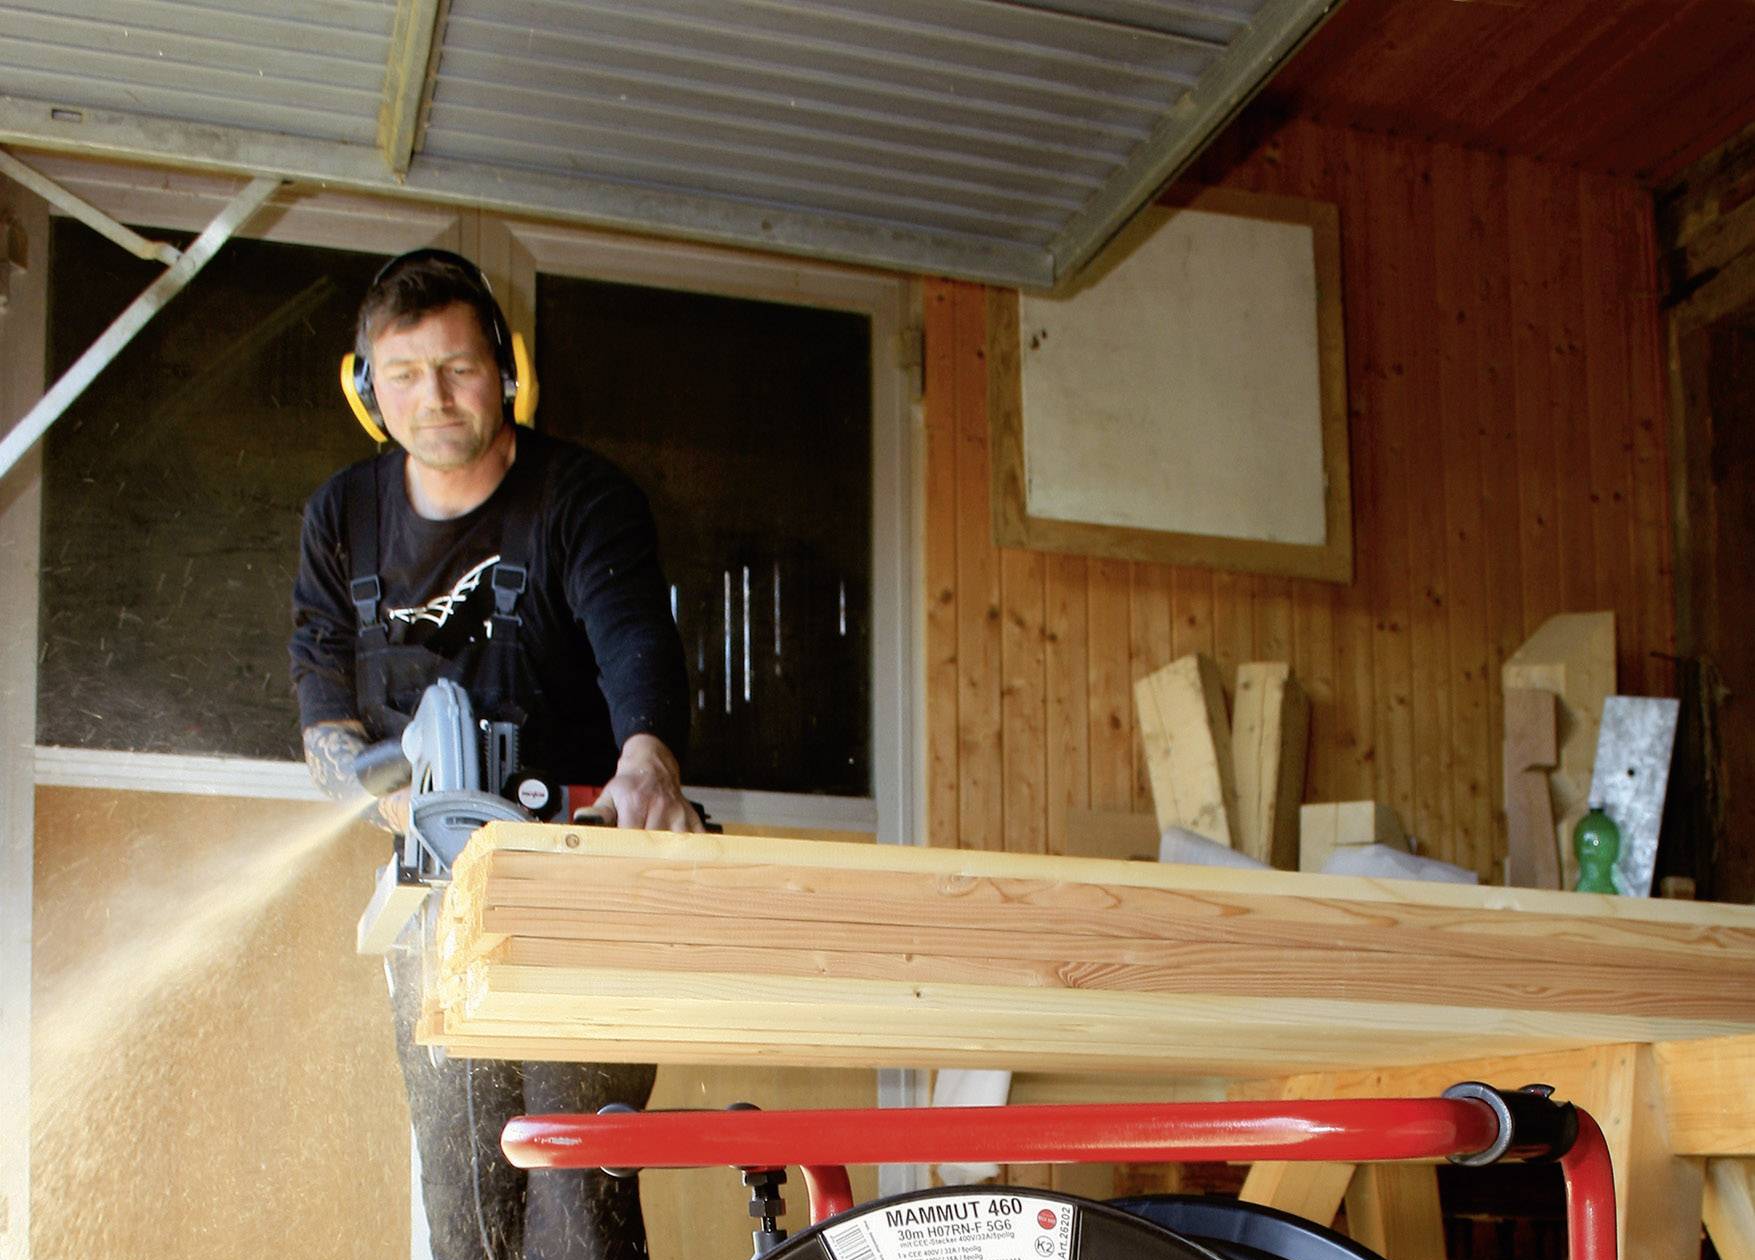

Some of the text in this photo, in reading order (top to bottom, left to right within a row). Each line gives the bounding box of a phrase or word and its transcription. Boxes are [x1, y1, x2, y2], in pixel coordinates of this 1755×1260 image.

[886, 1198, 1022, 1228] MAMMUT 460
[898, 1219, 1012, 1241] 30m H07RN-F 5G6
[1058, 1206, 1071, 1260] Art.26202
